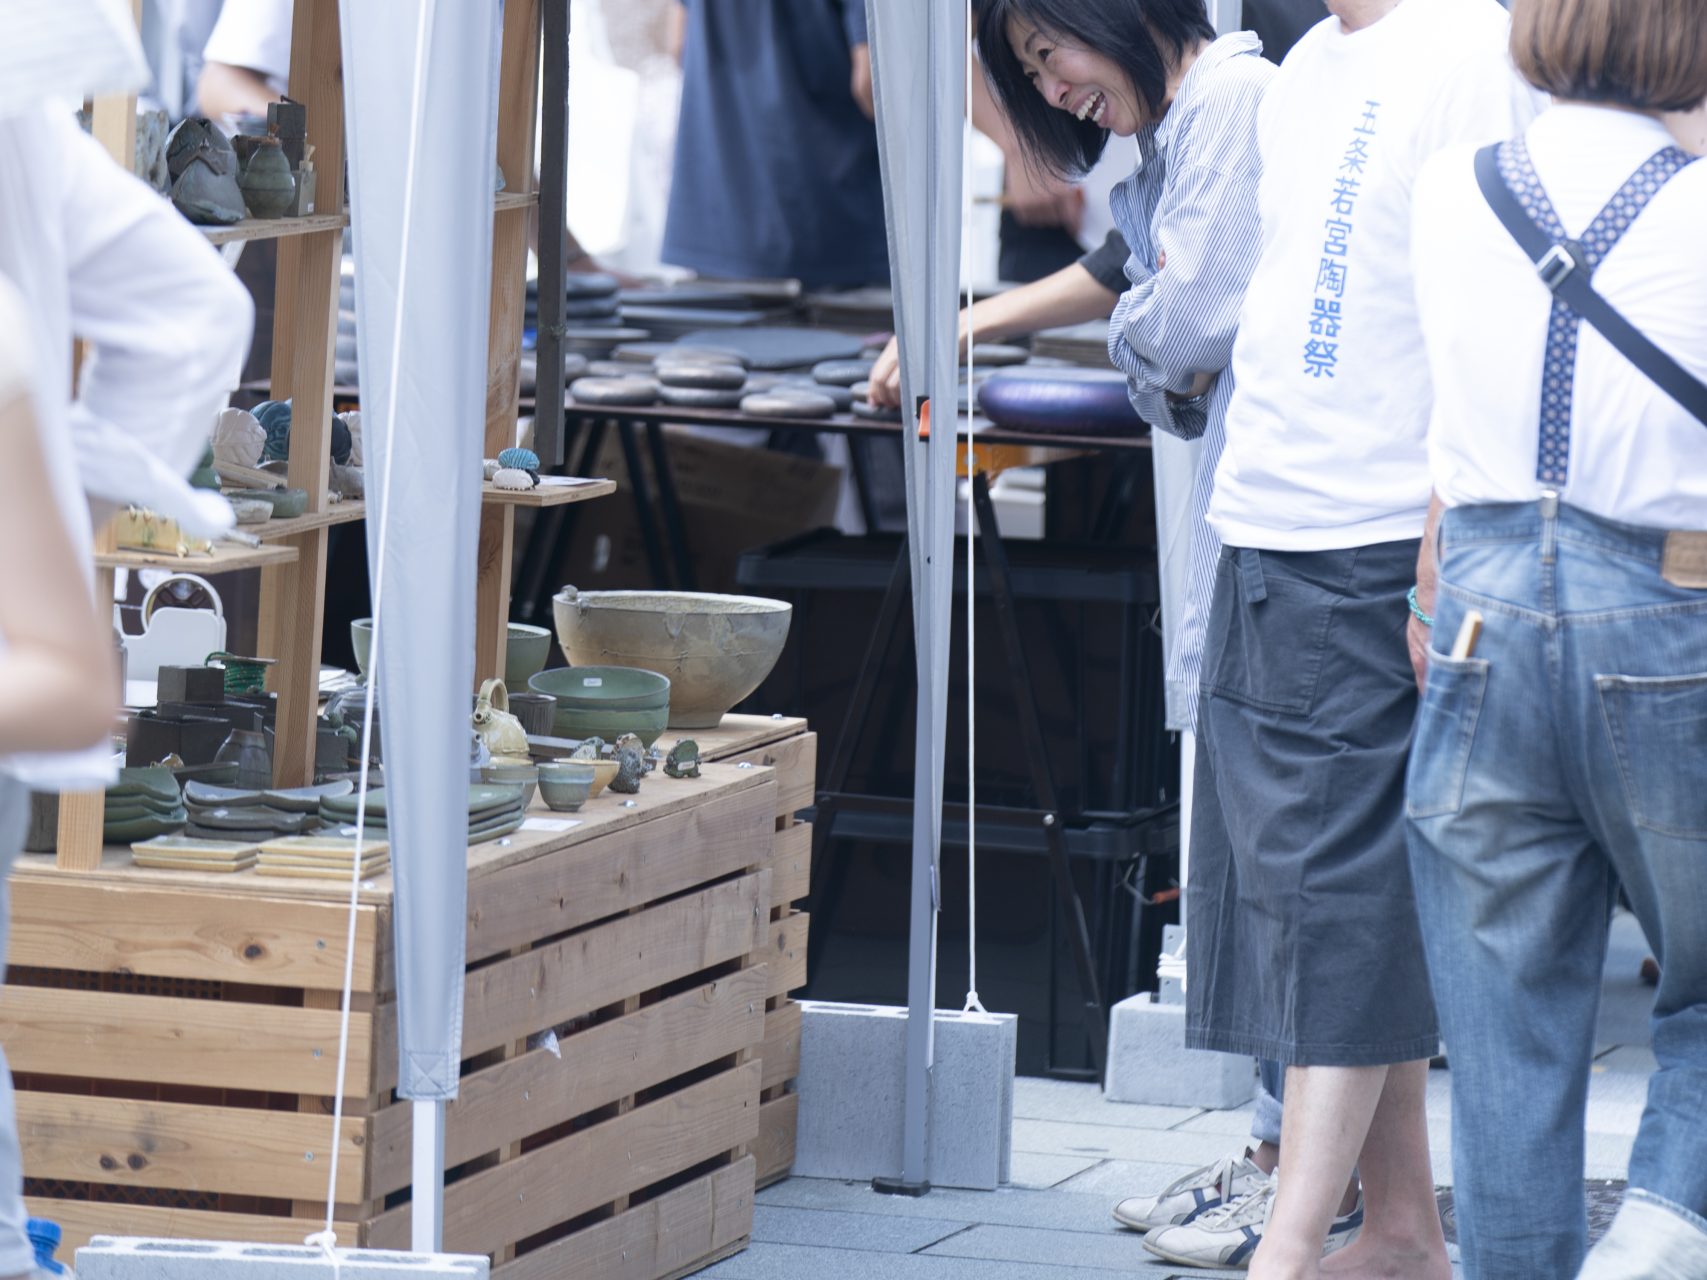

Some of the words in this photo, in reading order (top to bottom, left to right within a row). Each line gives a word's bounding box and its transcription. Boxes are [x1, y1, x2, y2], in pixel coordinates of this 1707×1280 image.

[1303, 99, 1381, 379] 五条若宮陶器祭
